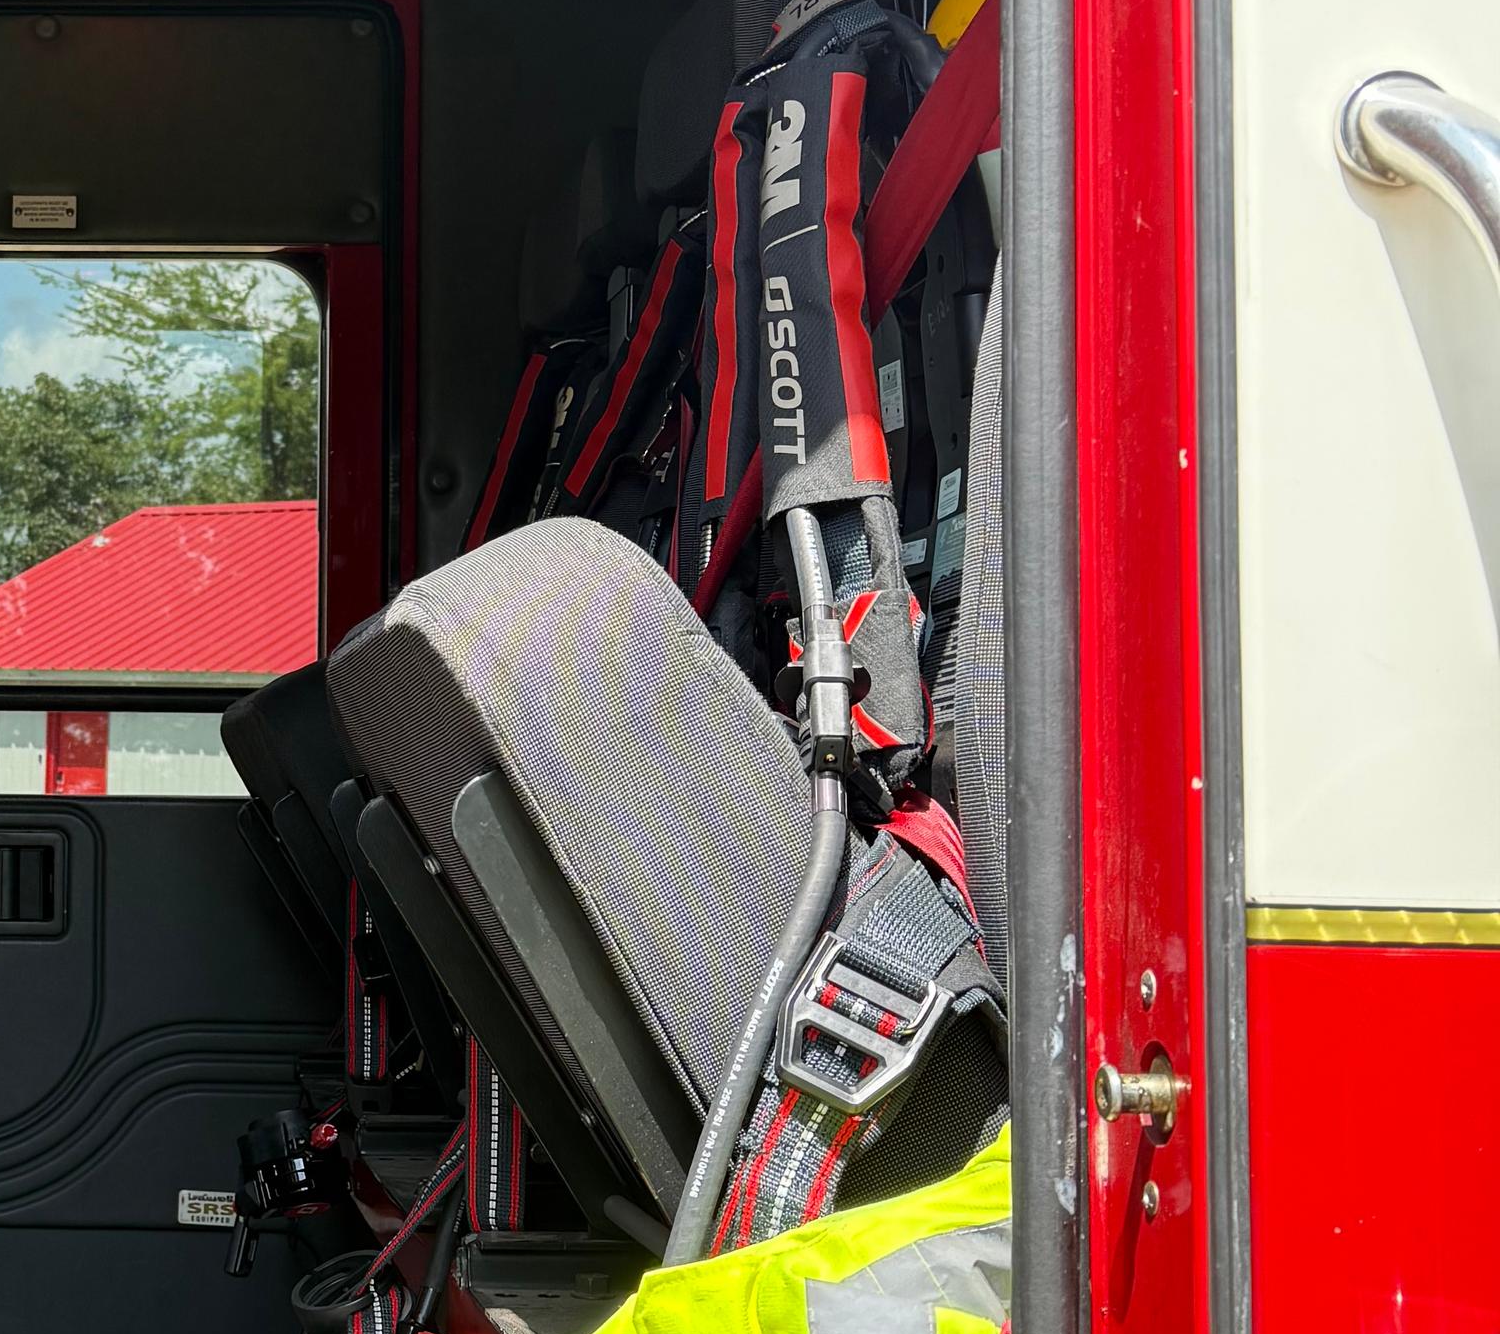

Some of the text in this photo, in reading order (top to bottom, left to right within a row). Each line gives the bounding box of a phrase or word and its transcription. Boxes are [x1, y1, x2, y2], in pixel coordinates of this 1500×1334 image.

[761, 100, 806, 465] 3M SCOTT
[758, 957, 784, 1004] SCOTT
[743, 1008, 762, 1040] MADE
[738, 1039, 750, 1053] IN
[726, 1052, 745, 1084] U.S.A.
[718, 1087, 732, 1107] 250
[711, 1107, 725, 1127] PSI
[704, 1129, 717, 1149] P/N
[187, 1202, 234, 1216] SRS
[191, 1215, 231, 1224] EQUIPPED
